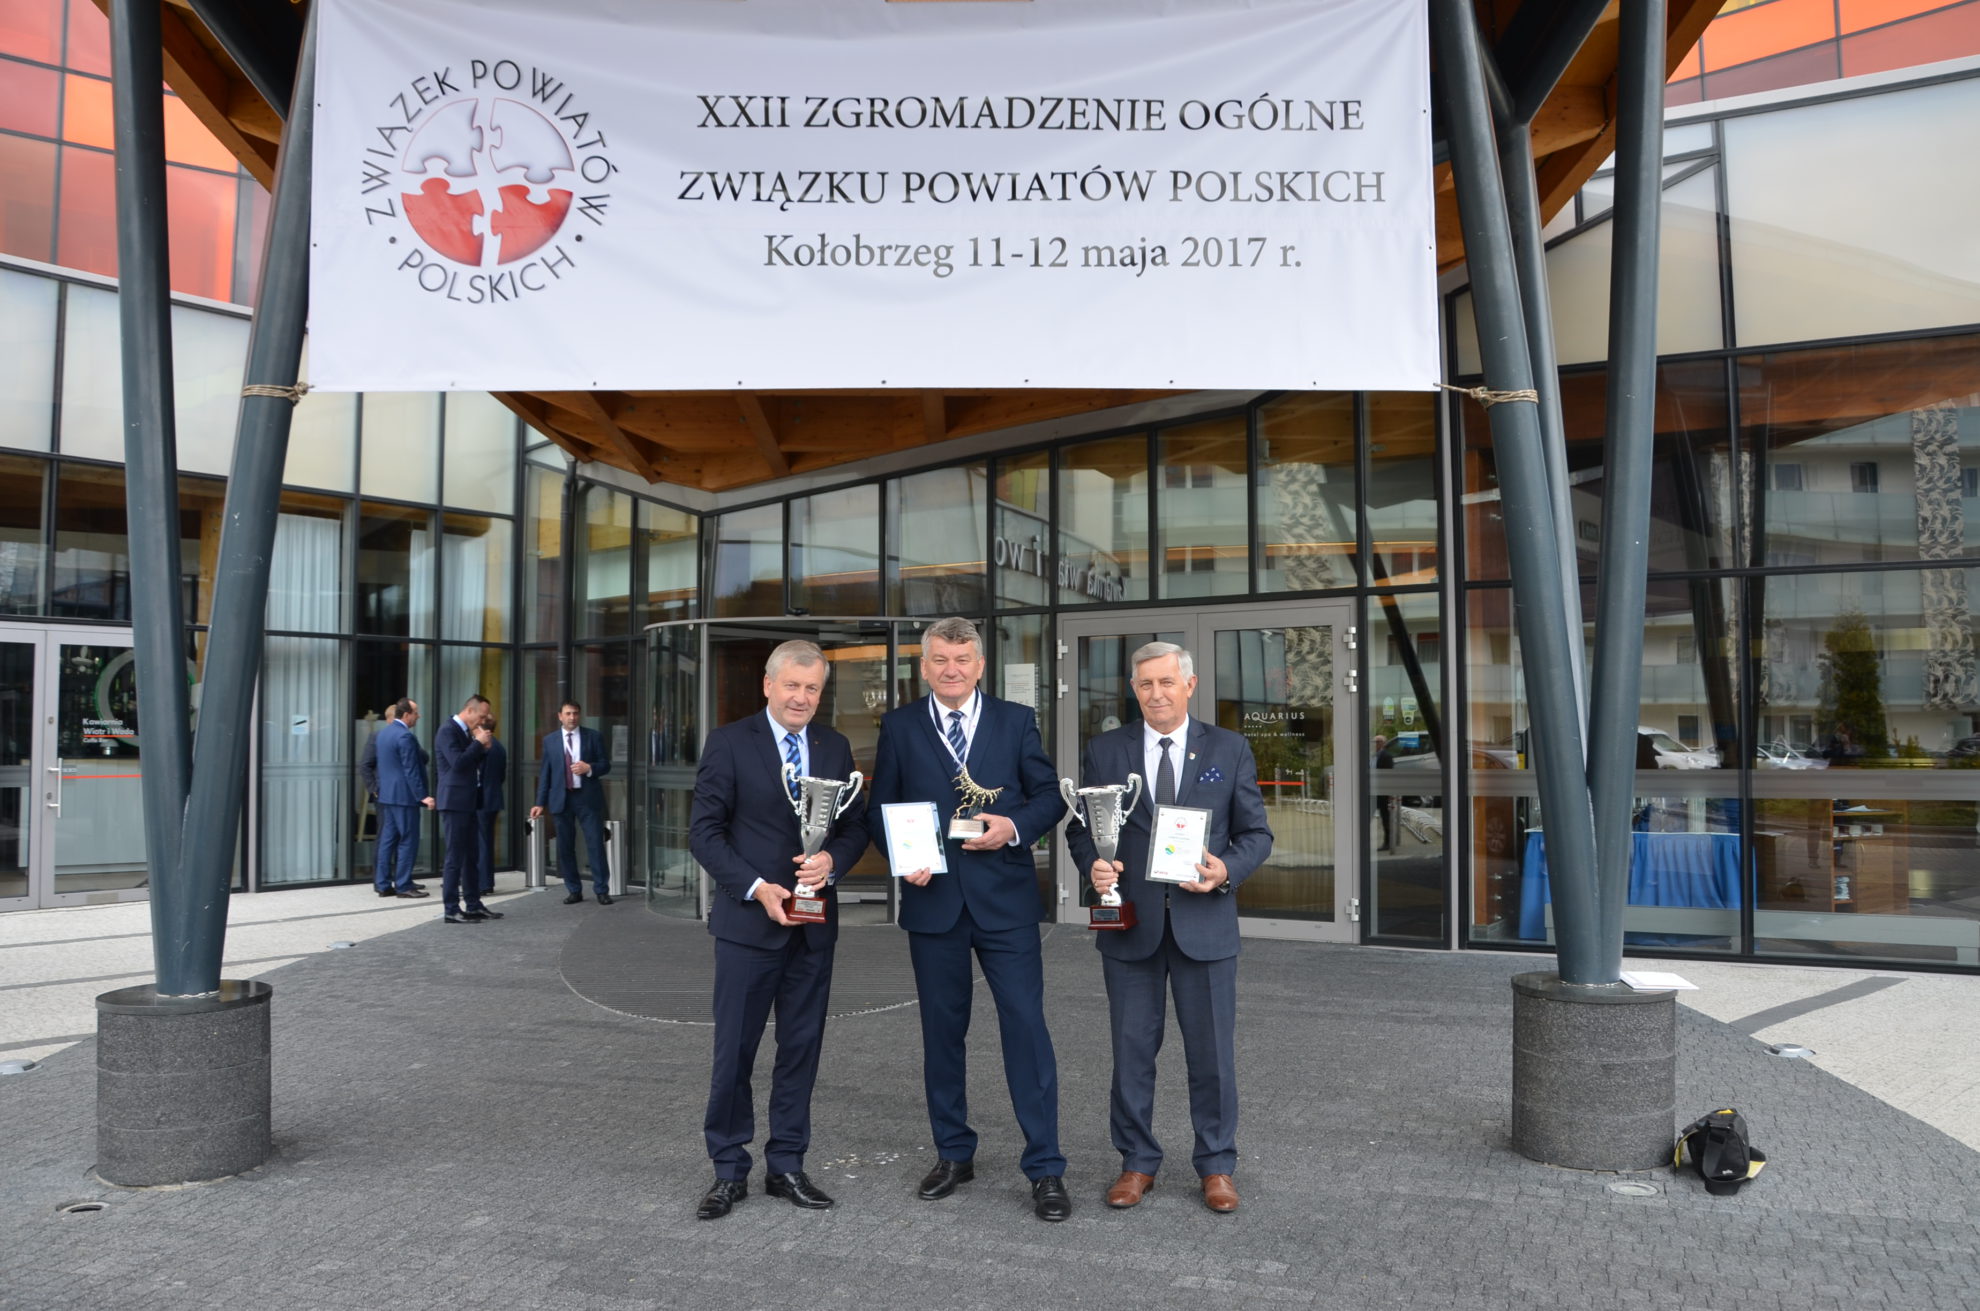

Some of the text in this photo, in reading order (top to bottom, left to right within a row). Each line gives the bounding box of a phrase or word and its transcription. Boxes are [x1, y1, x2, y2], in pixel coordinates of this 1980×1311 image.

[696, 92, 1365, 132] XXII ZGROMADZENIE OGÓLNE
[361, 59, 619, 227] ZWIĄZEK POWIATÓW
[677, 164, 1387, 212] ZWIĄZKU POWIATÓW POLSKICH
[398, 245, 576, 305] POLSKICH
[763, 233, 1303, 279] Kołobrzeg 11-12 maja 2017 r.
[1243, 711, 1306, 724] AQUARIUS
